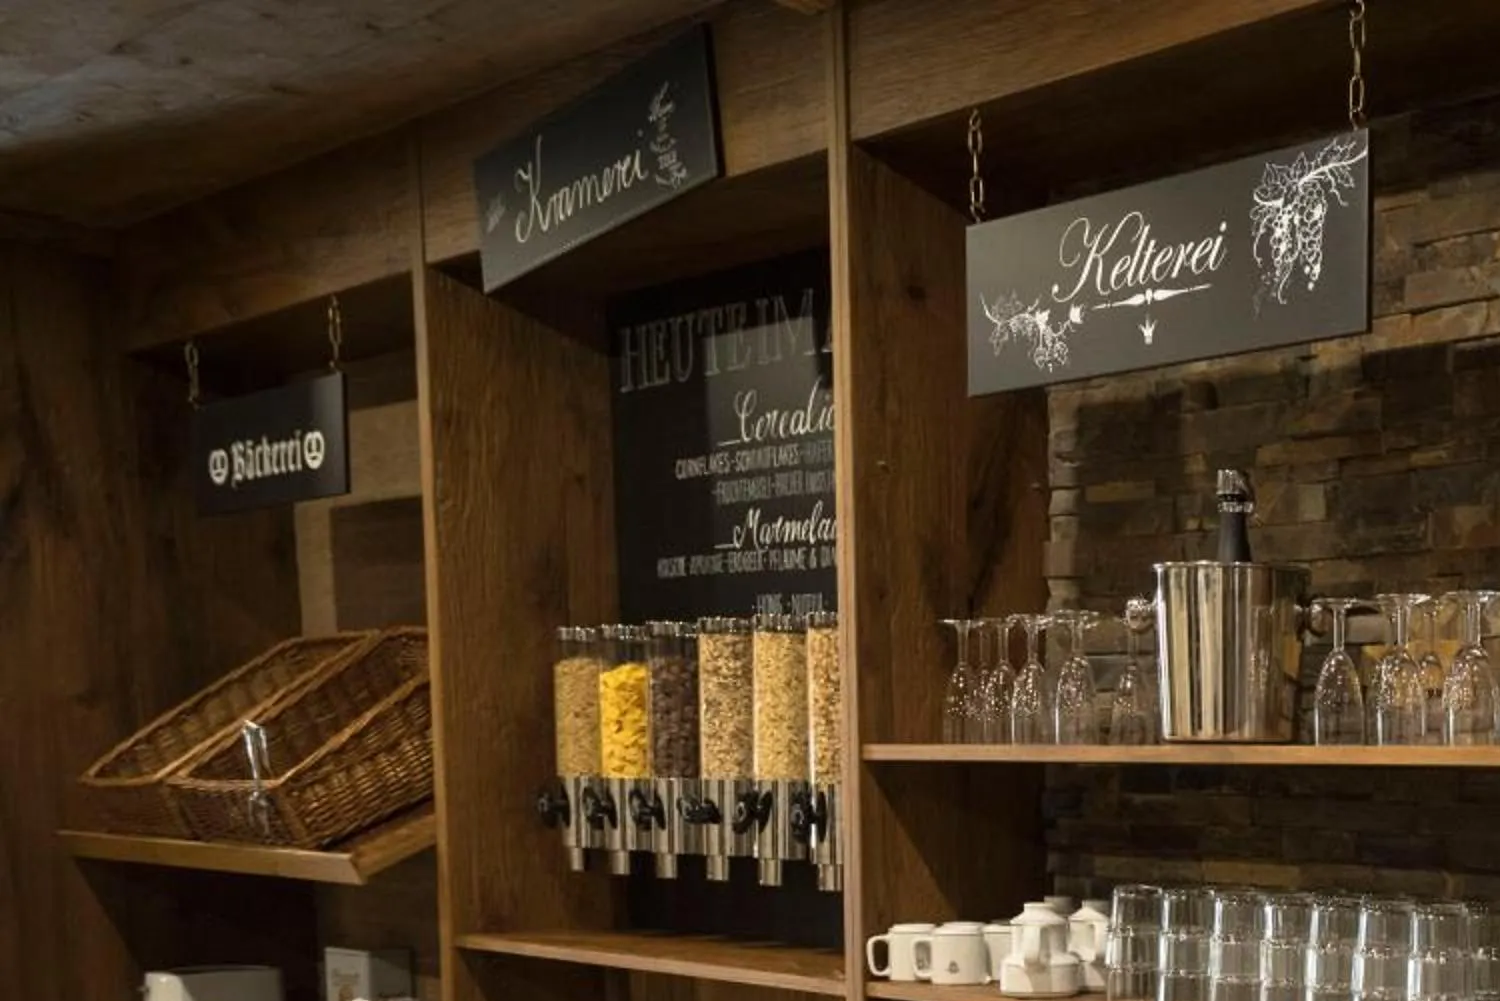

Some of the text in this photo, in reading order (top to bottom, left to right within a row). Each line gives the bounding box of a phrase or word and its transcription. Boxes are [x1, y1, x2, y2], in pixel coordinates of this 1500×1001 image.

[1052, 211, 1227, 303] Kelterei
[619, 302, 747, 393] HEUTE
[755, 288, 816, 364] IM
[231, 430, 302, 489] Bäckerei
[732, 499, 837, 550] Marmela
